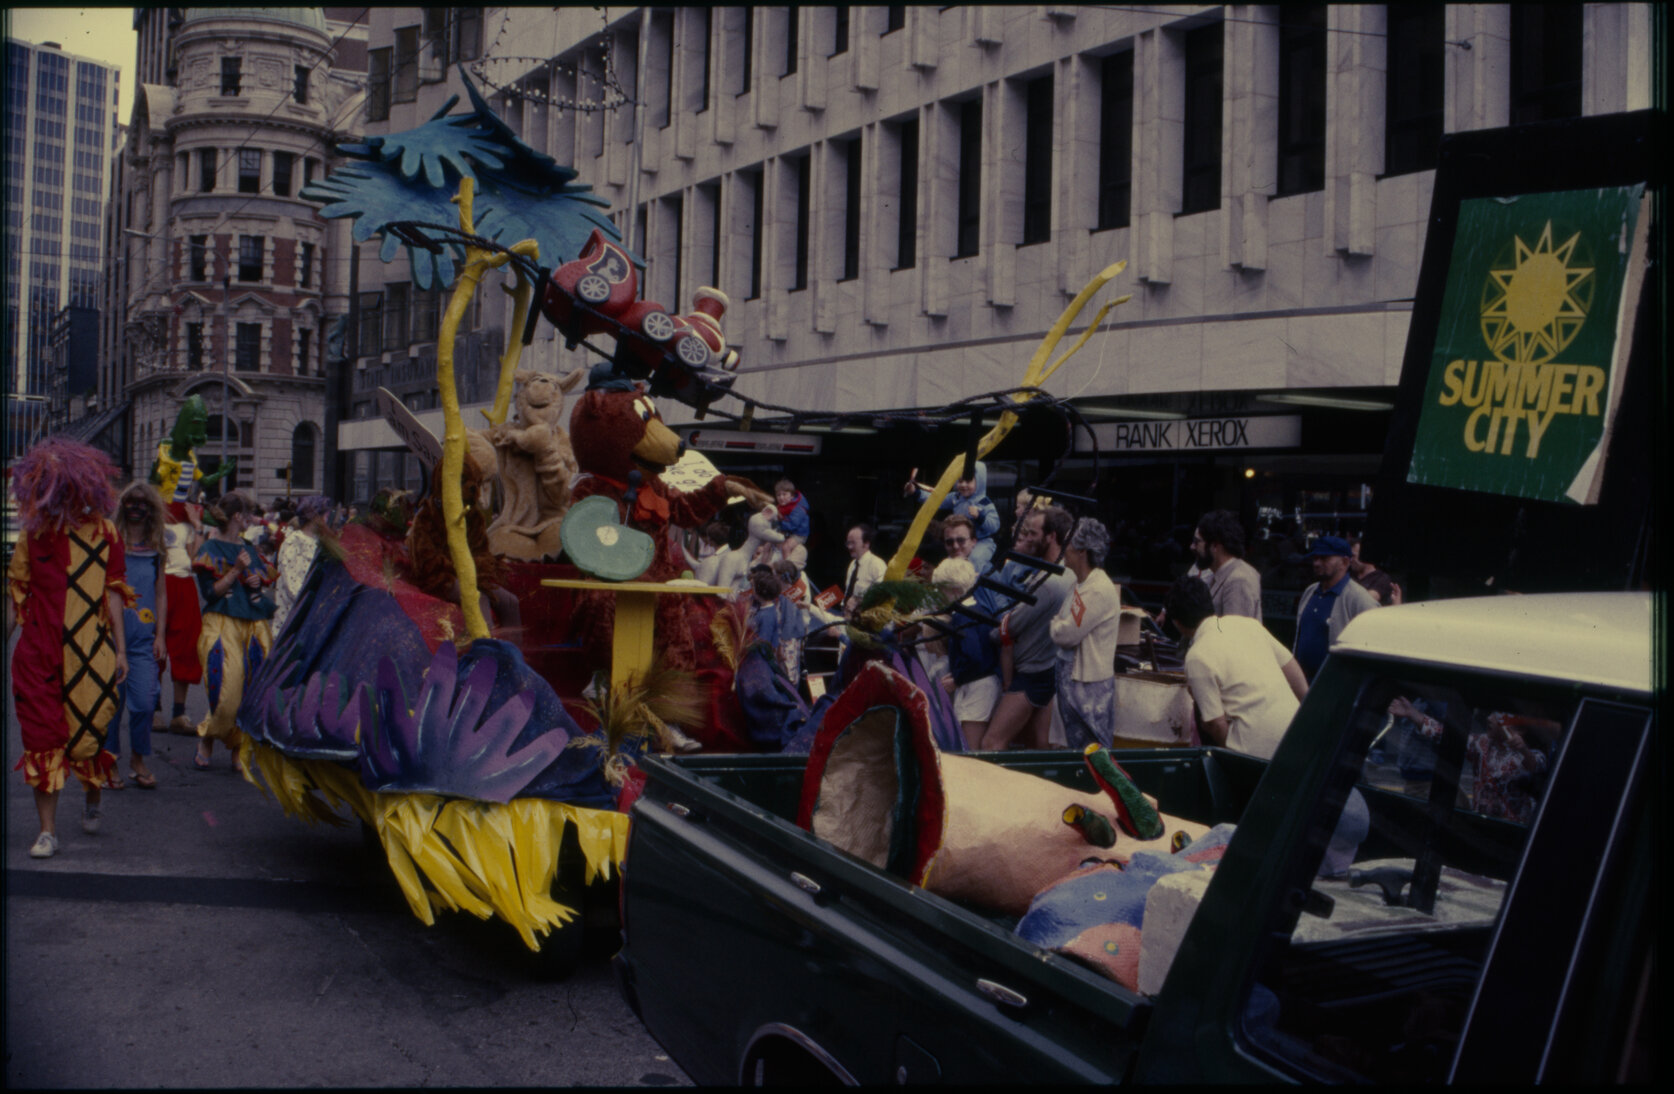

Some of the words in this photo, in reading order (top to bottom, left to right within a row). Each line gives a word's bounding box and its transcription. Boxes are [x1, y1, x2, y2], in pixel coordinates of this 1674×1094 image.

[1438, 359, 1606, 417] SUMMER
[1115, 422, 1173, 449] RANK
[1184, 419, 1250, 447] XEROX
[1463, 406, 1557, 459] CITY
